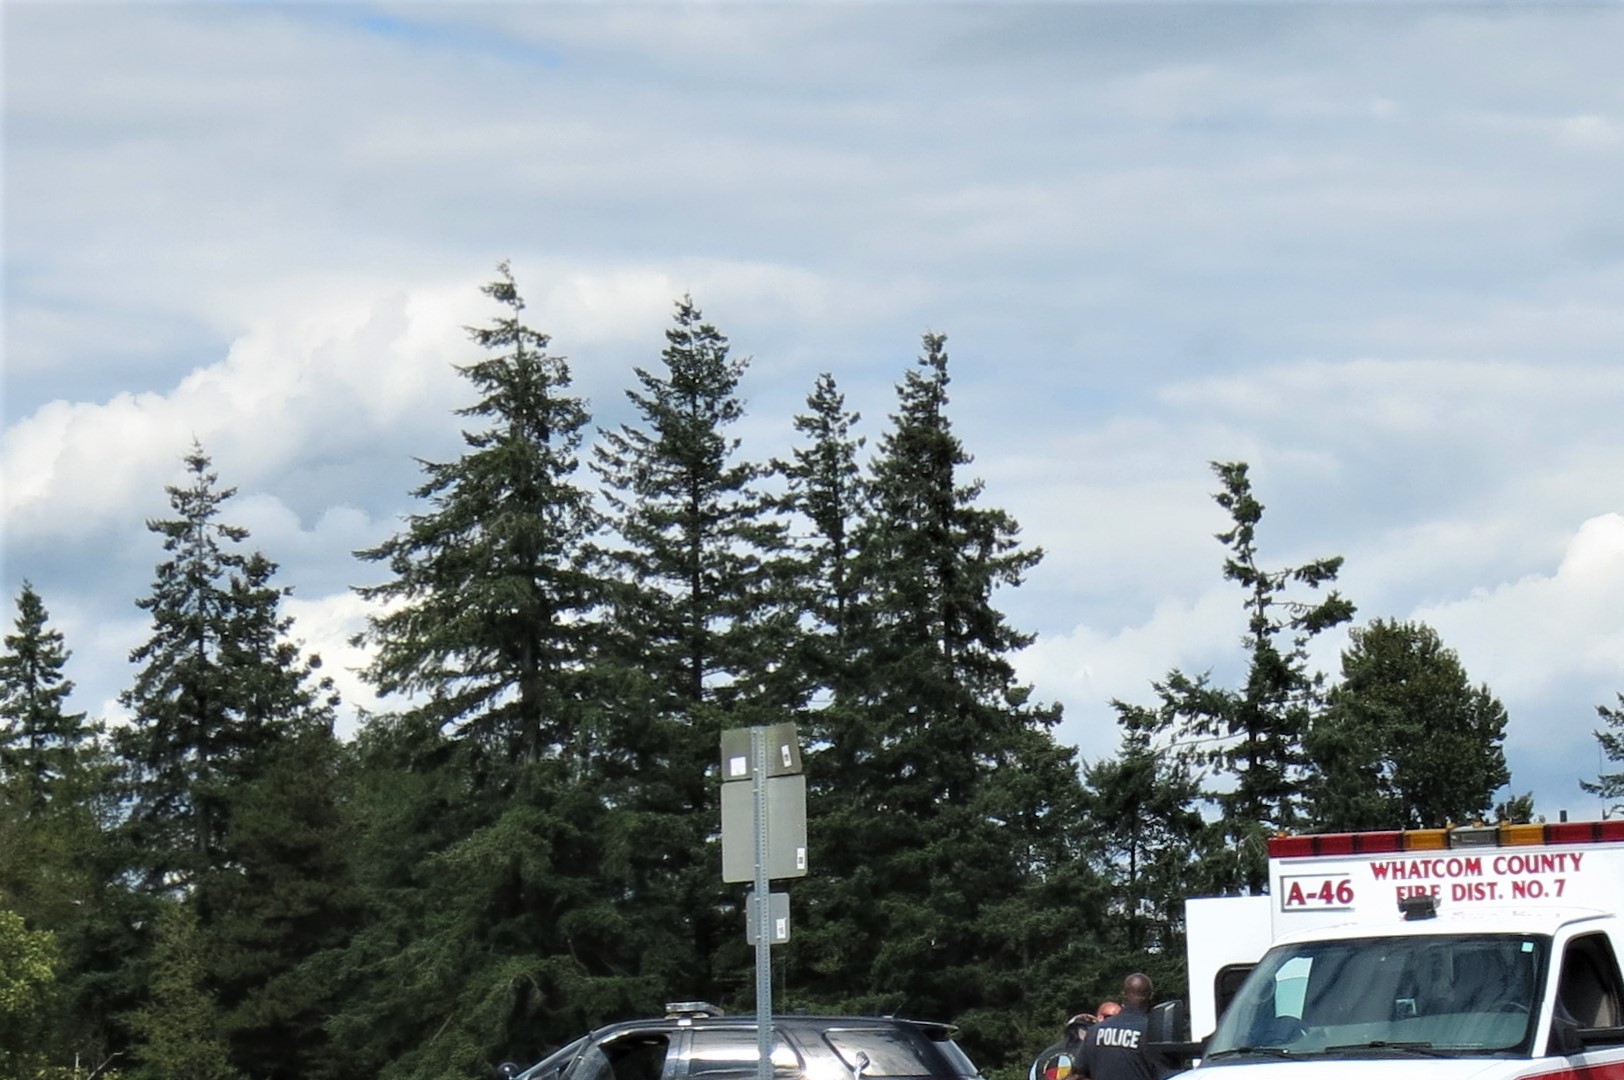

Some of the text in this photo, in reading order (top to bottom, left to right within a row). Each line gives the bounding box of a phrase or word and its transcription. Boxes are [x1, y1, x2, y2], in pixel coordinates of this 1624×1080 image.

[1369, 853, 1584, 881] WHATCOM COUNTY
[1285, 880, 1354, 906] A-46
[1451, 882, 1504, 901] DIST.
[1511, 880, 1549, 899] NO.
[1554, 879, 1566, 898] 7
[1096, 1028, 1141, 1048] POLICE
